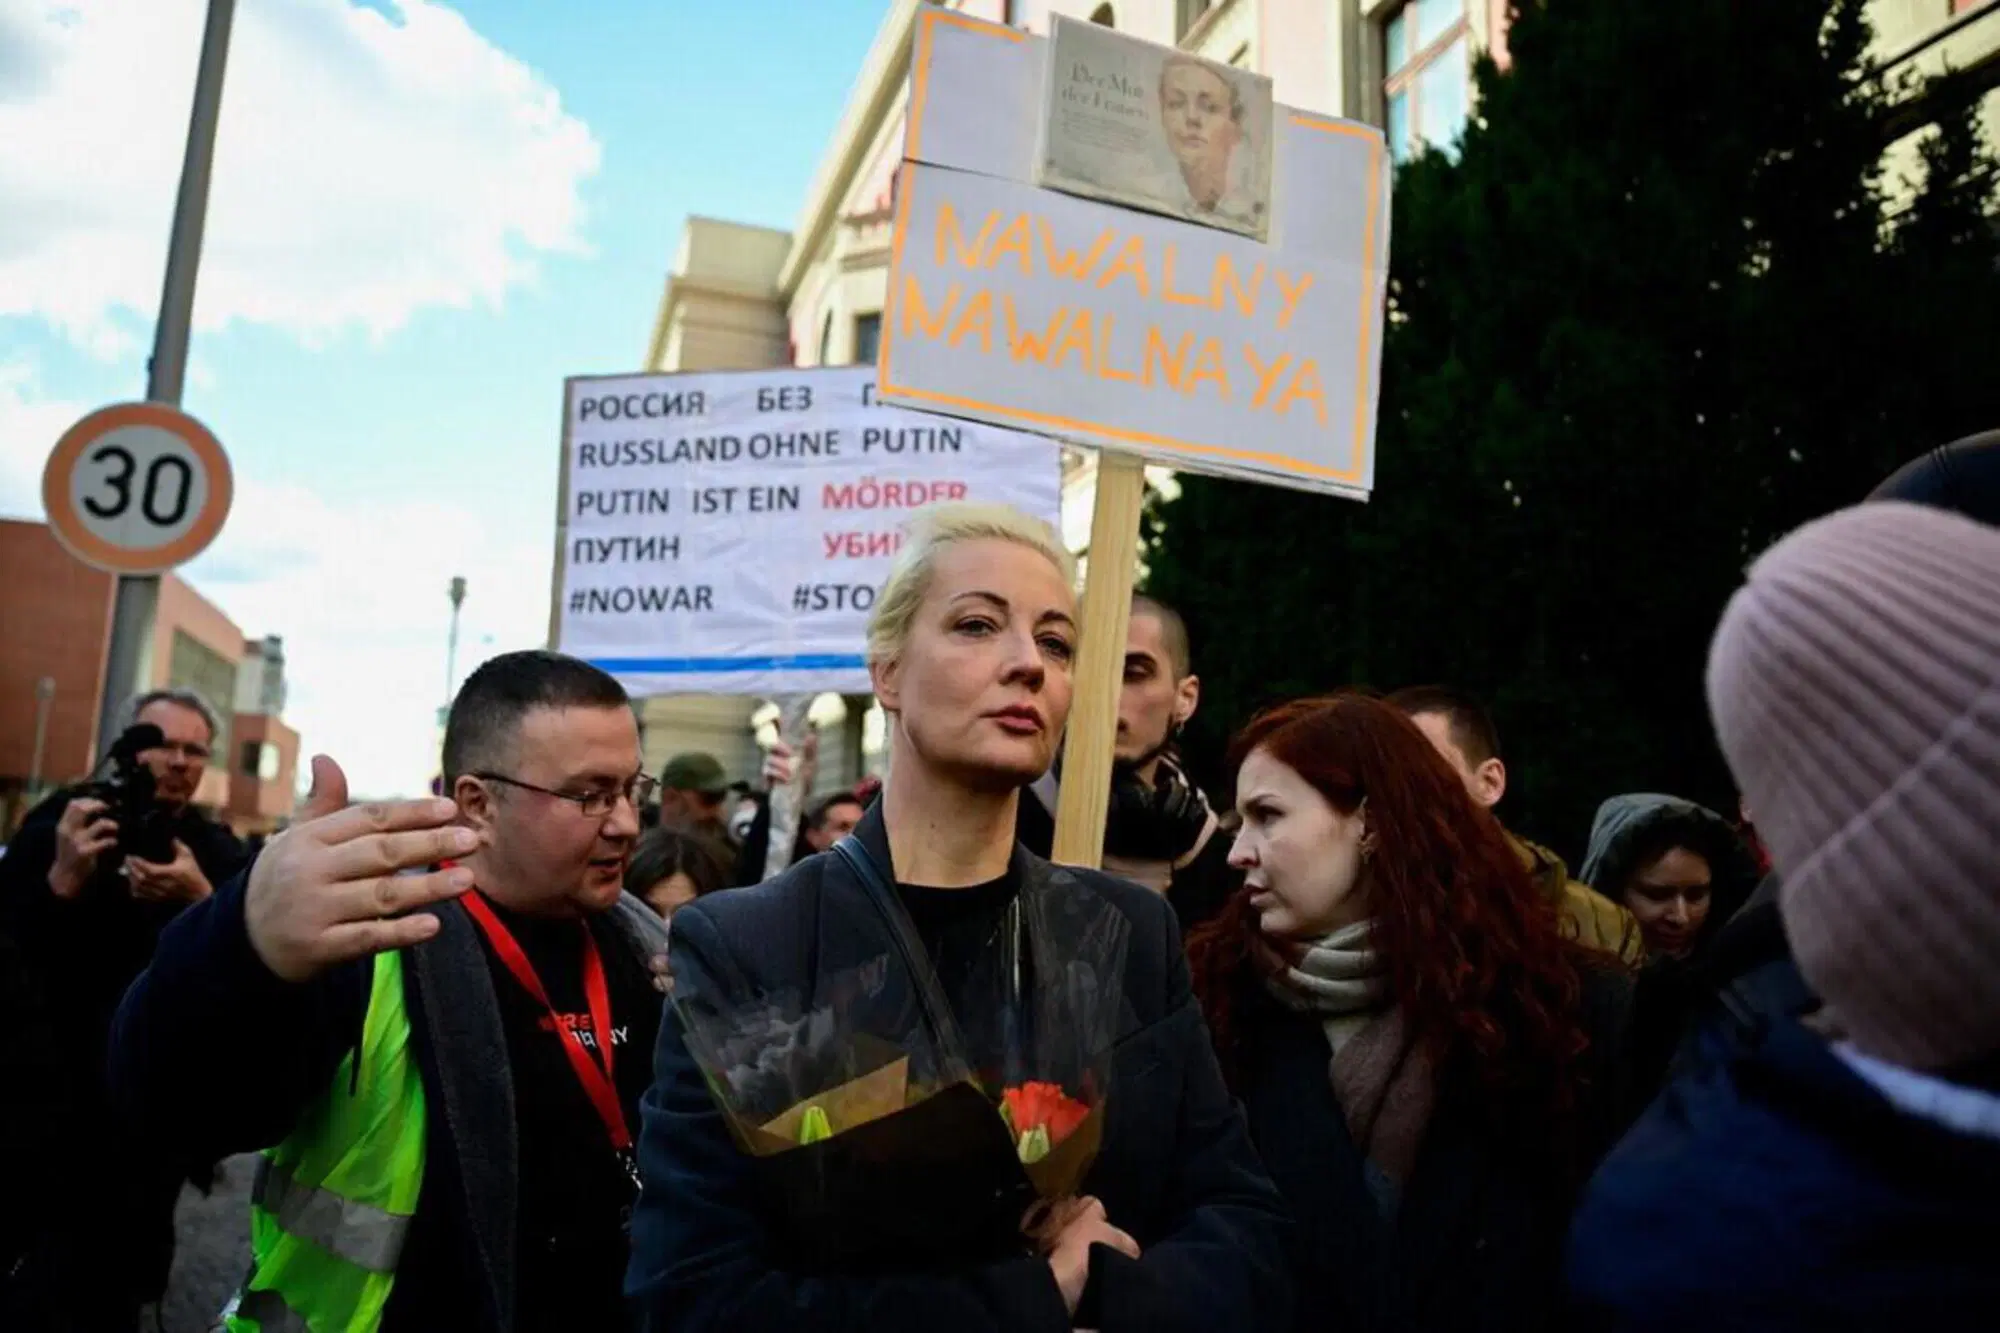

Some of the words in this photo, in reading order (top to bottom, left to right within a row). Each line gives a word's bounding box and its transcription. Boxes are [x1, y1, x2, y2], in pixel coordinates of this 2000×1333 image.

[935, 203, 1315, 330] NAWALNY
[901, 273, 1328, 429] NAWALNAYA
[579, 390, 706, 421] РОССИЯ
[756, 386, 813, 412] БЕЗ
[578, 434, 742, 468] RUSSLAND
[748, 429, 840, 460] OHNE
[863, 426, 962, 453] PUTIN
[82, 445, 192, 527] 30
[577, 488, 670, 515] PUTIN
[693, 486, 738, 513] IST
[748, 484, 800, 512] EIN
[822, 476, 968, 509] MÖRDER
[573, 533, 681, 563] ПУТИН
[569, 584, 714, 613] #NOWAR
[793, 583, 876, 612] #STO
